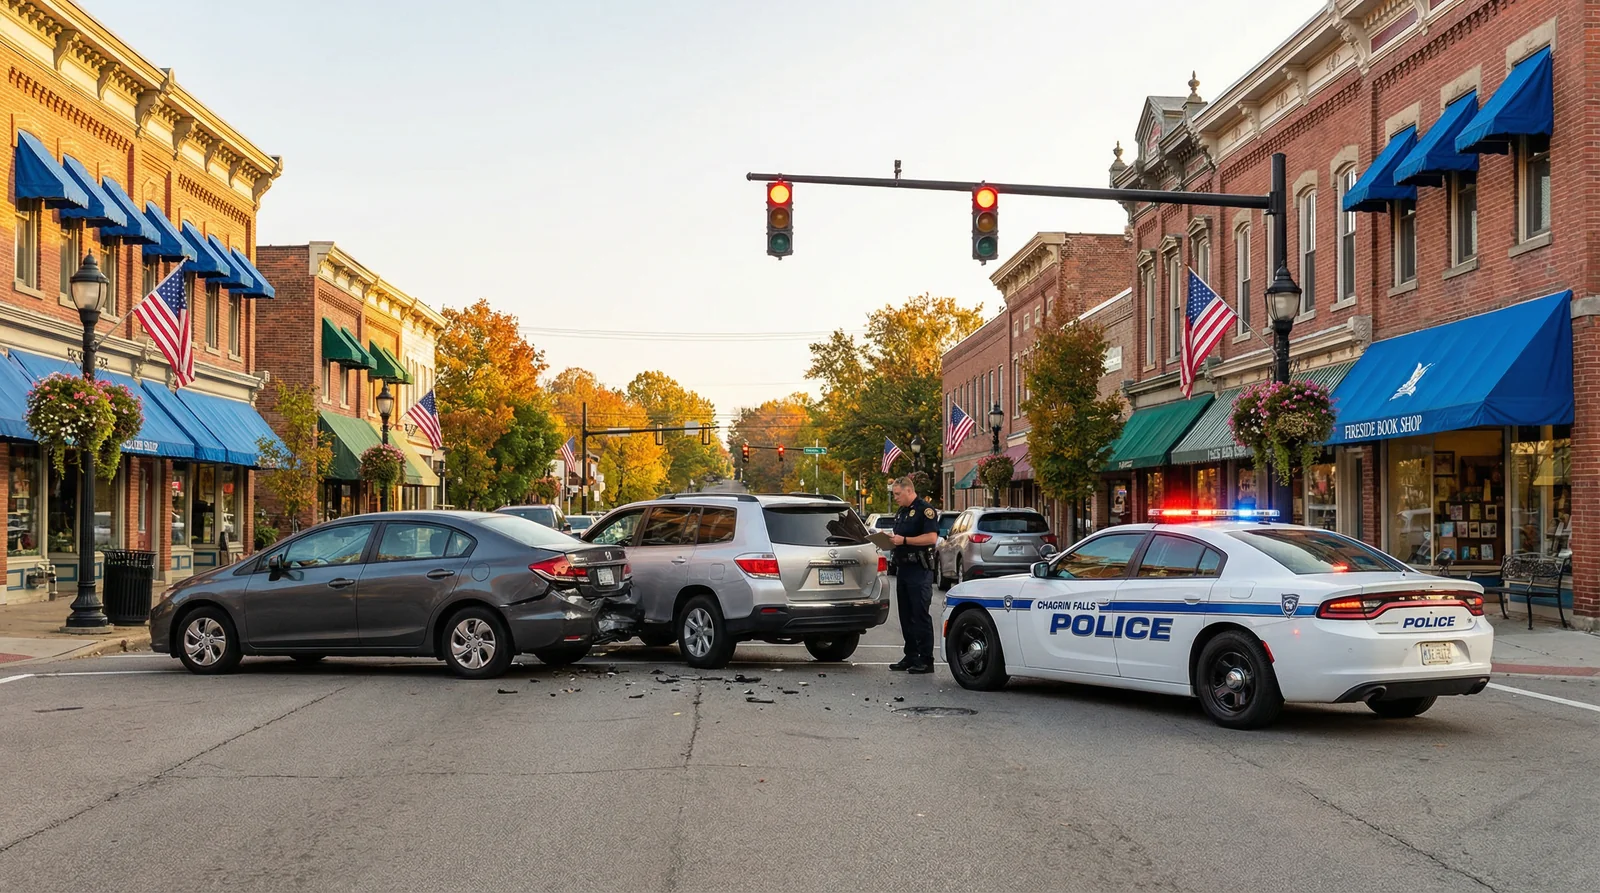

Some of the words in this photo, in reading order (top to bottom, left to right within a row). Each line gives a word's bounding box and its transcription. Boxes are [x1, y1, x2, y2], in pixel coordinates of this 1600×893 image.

[1345, 421, 1376, 440] FIRESIDE
[1377, 418, 1398, 436] BOOK
[1400, 414, 1422, 433] SHOP
[1037, 600, 1071, 610] CHAGRIN
[1072, 601, 1096, 611] FALLS
[1050, 613, 1174, 641] POLICE
[1402, 615, 1456, 629] POLICE
